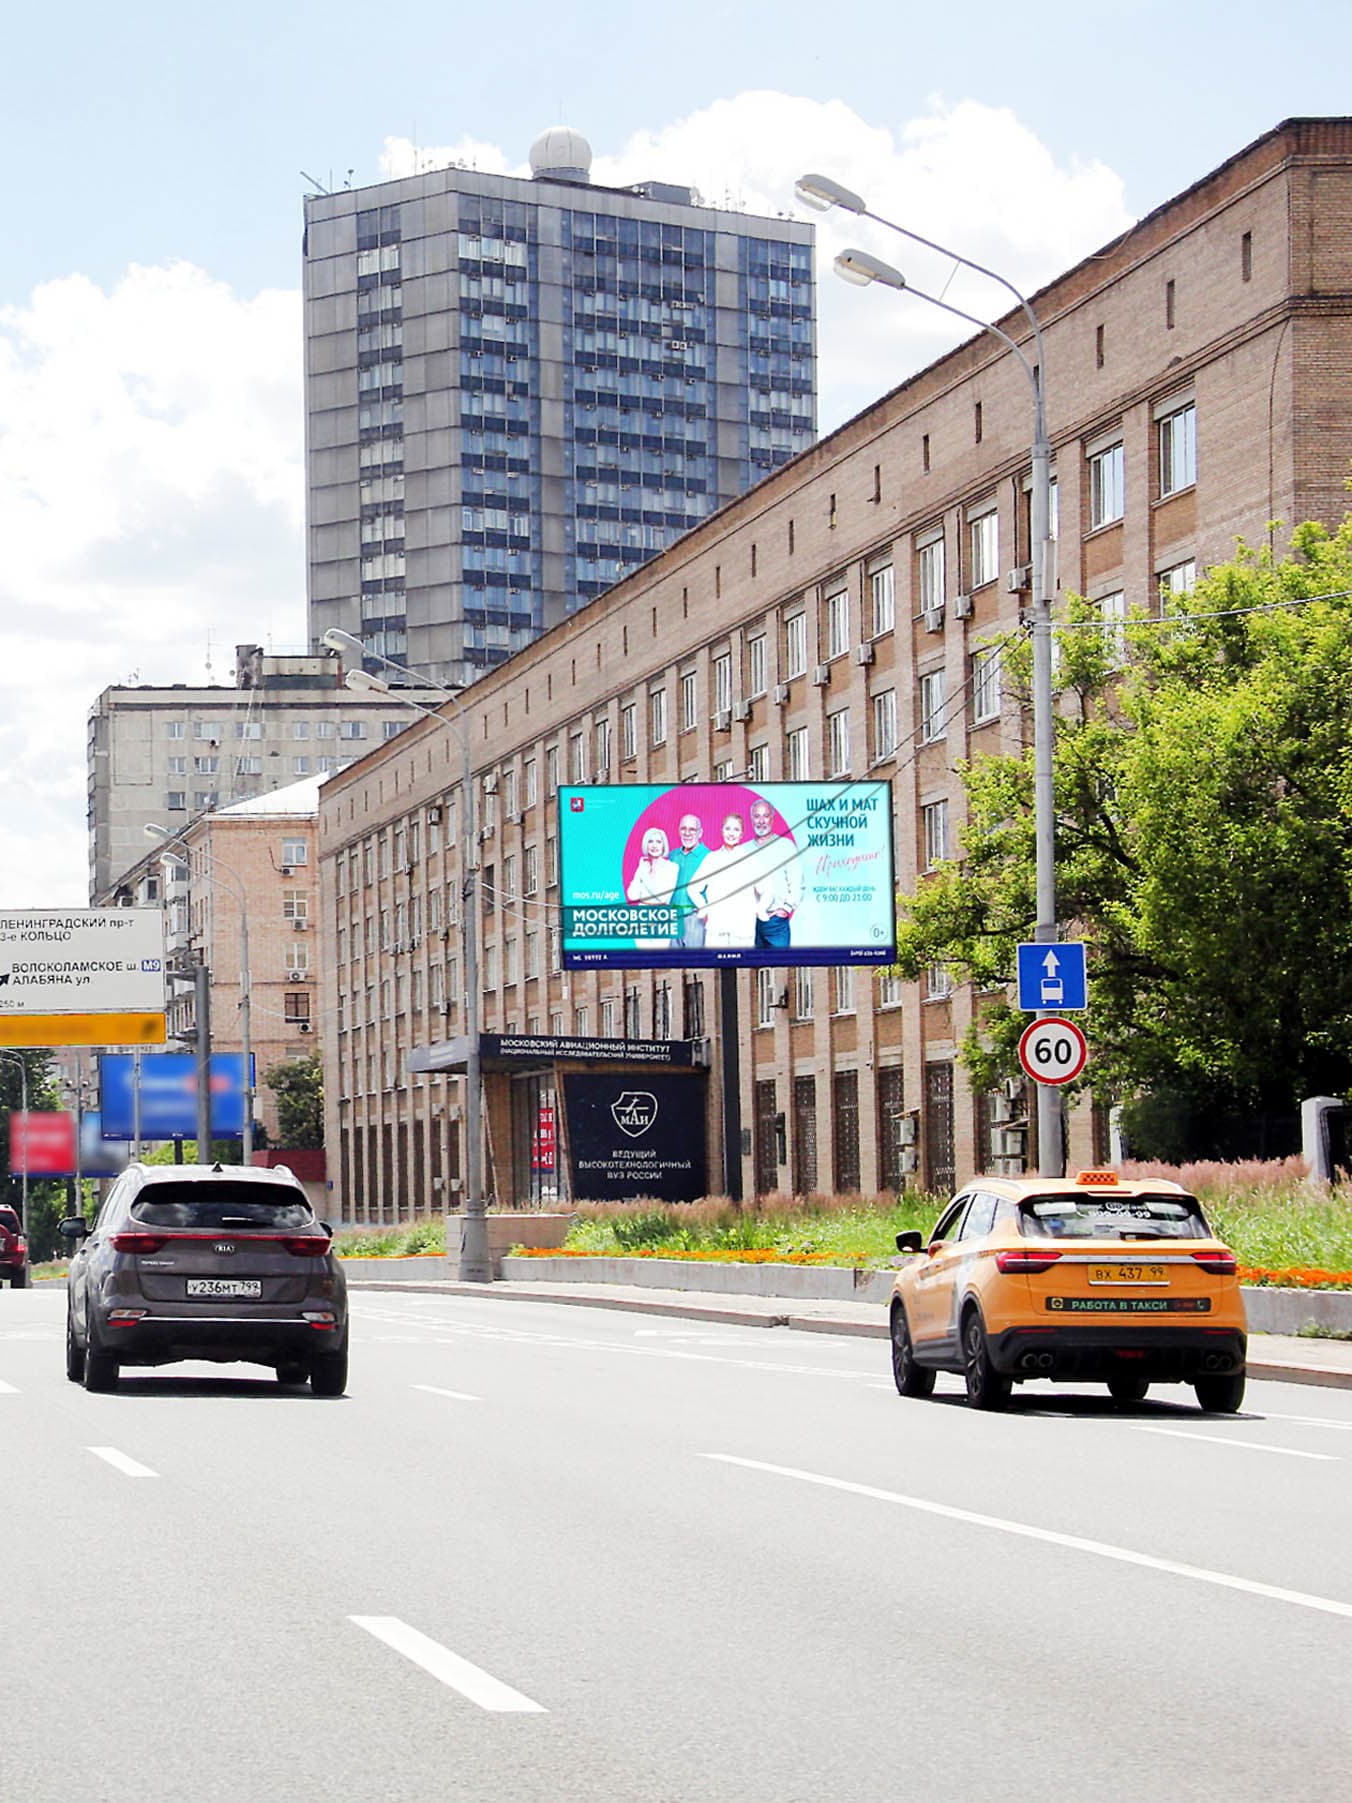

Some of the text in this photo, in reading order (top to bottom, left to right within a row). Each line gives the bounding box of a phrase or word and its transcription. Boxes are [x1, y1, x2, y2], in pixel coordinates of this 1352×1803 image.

[806, 798, 879, 811] ШАХ И МАТ
[807, 813, 868, 829] СКУЧНОЙ
[808, 833, 854, 847] ЖИЗНИ
[572, 909, 678, 921] МОСКОВСКОЕ
[0, 917, 135, 930] ЛЕНИНГРАДСКИЙ пр-т
[572, 923, 679, 937] ДОЛГОЛЕТИЕ
[0, 931, 72, 942] 3-е КОЛЬЦО
[12, 960, 123, 973] ВОЛОКОЛАМСКОЕ
[13, 975, 73, 985] АЛАБЯНА
[500, 1039, 670, 1053] МОСКОВСКИЙ АВИАЦИОННЫЙ ИНСТИТУТ
[1034, 1038, 1072, 1065] 60
[612, 1149, 657, 1159] ВЕДУЩИЙ
[578, 1160, 692, 1169] ВЫСОКОТЕХНОЛОГИЧНЫЙ
[607, 1171, 662, 1180] ВУЗ РОССИИ
[1118, 1267, 1142, 1280] 437
[1071, 1301, 1116, 1310] РАБОТА
[1119, 1301, 1127, 1310] В
[1131, 1301, 1168, 1310] ТАКСИ
